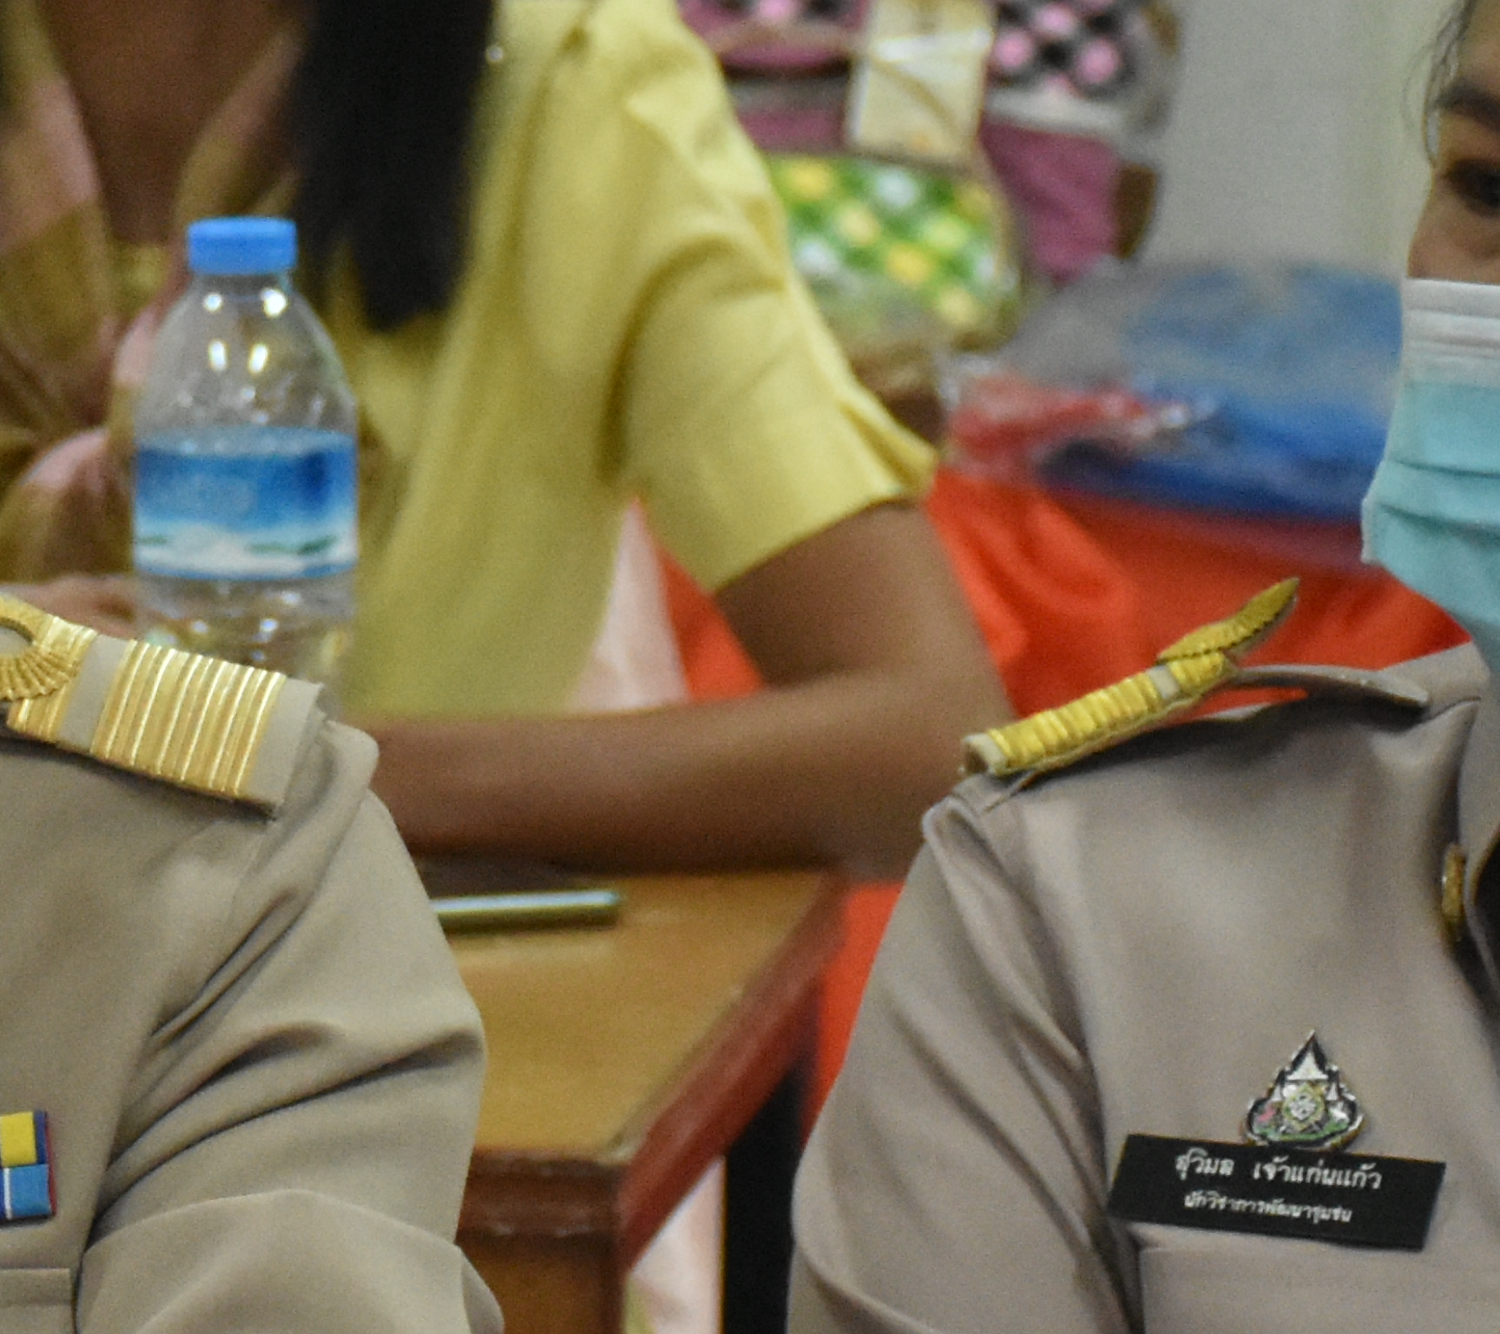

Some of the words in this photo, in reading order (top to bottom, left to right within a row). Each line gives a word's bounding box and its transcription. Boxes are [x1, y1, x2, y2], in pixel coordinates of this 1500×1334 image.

[1252, 1154, 1383, 1190] เจ้าแก่นแก้ว
